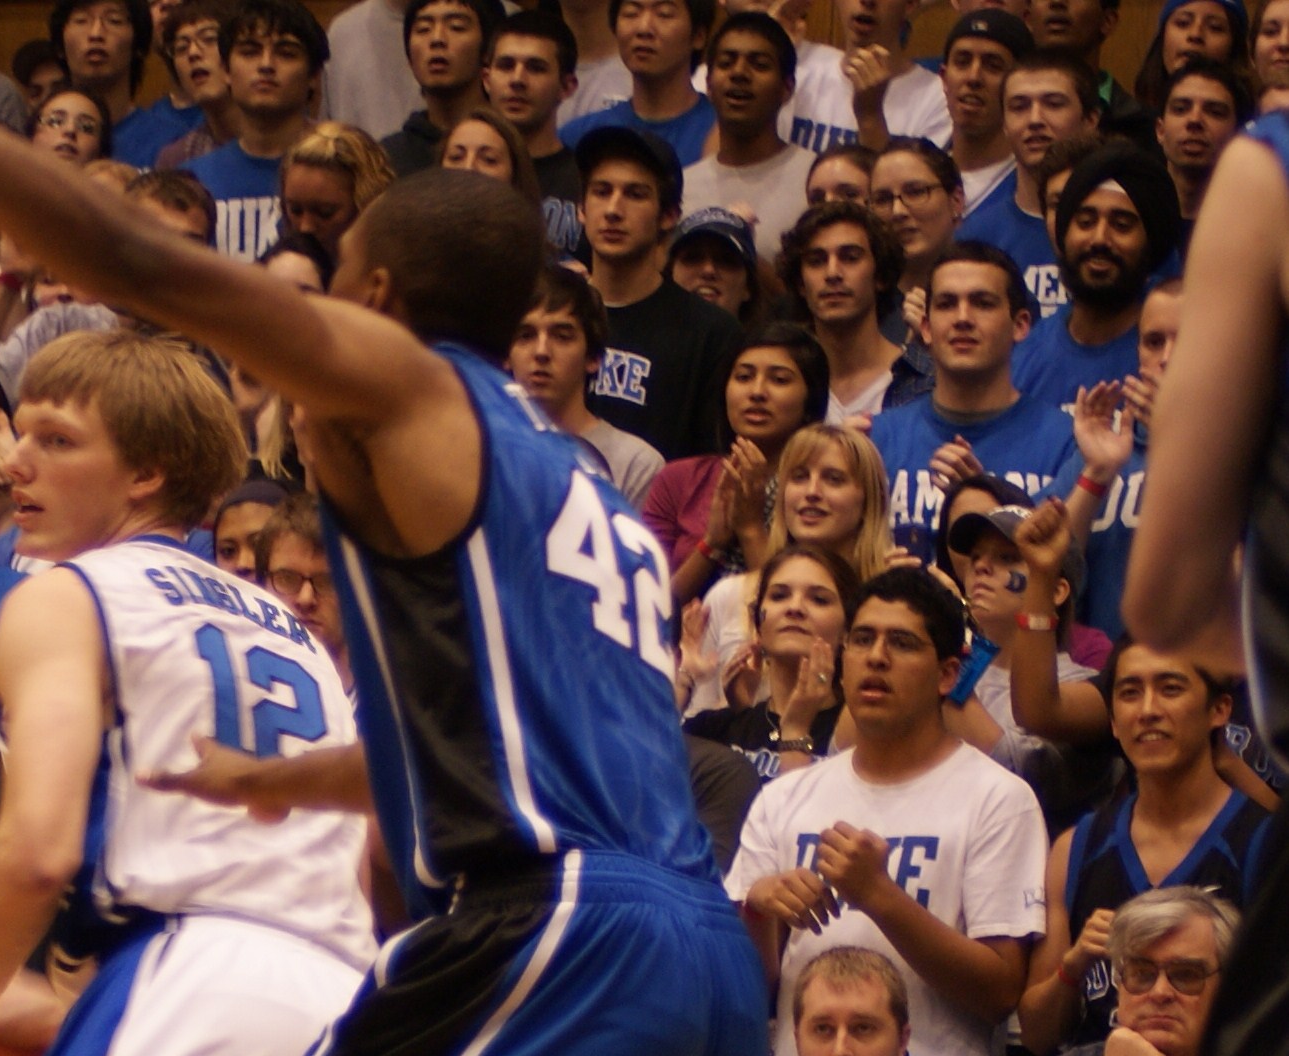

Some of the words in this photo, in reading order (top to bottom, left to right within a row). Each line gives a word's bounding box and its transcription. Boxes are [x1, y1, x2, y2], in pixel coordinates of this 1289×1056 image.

[593, 347, 652, 405] KE
[546, 469, 677, 690] 42
[194, 623, 328, 759] 12
